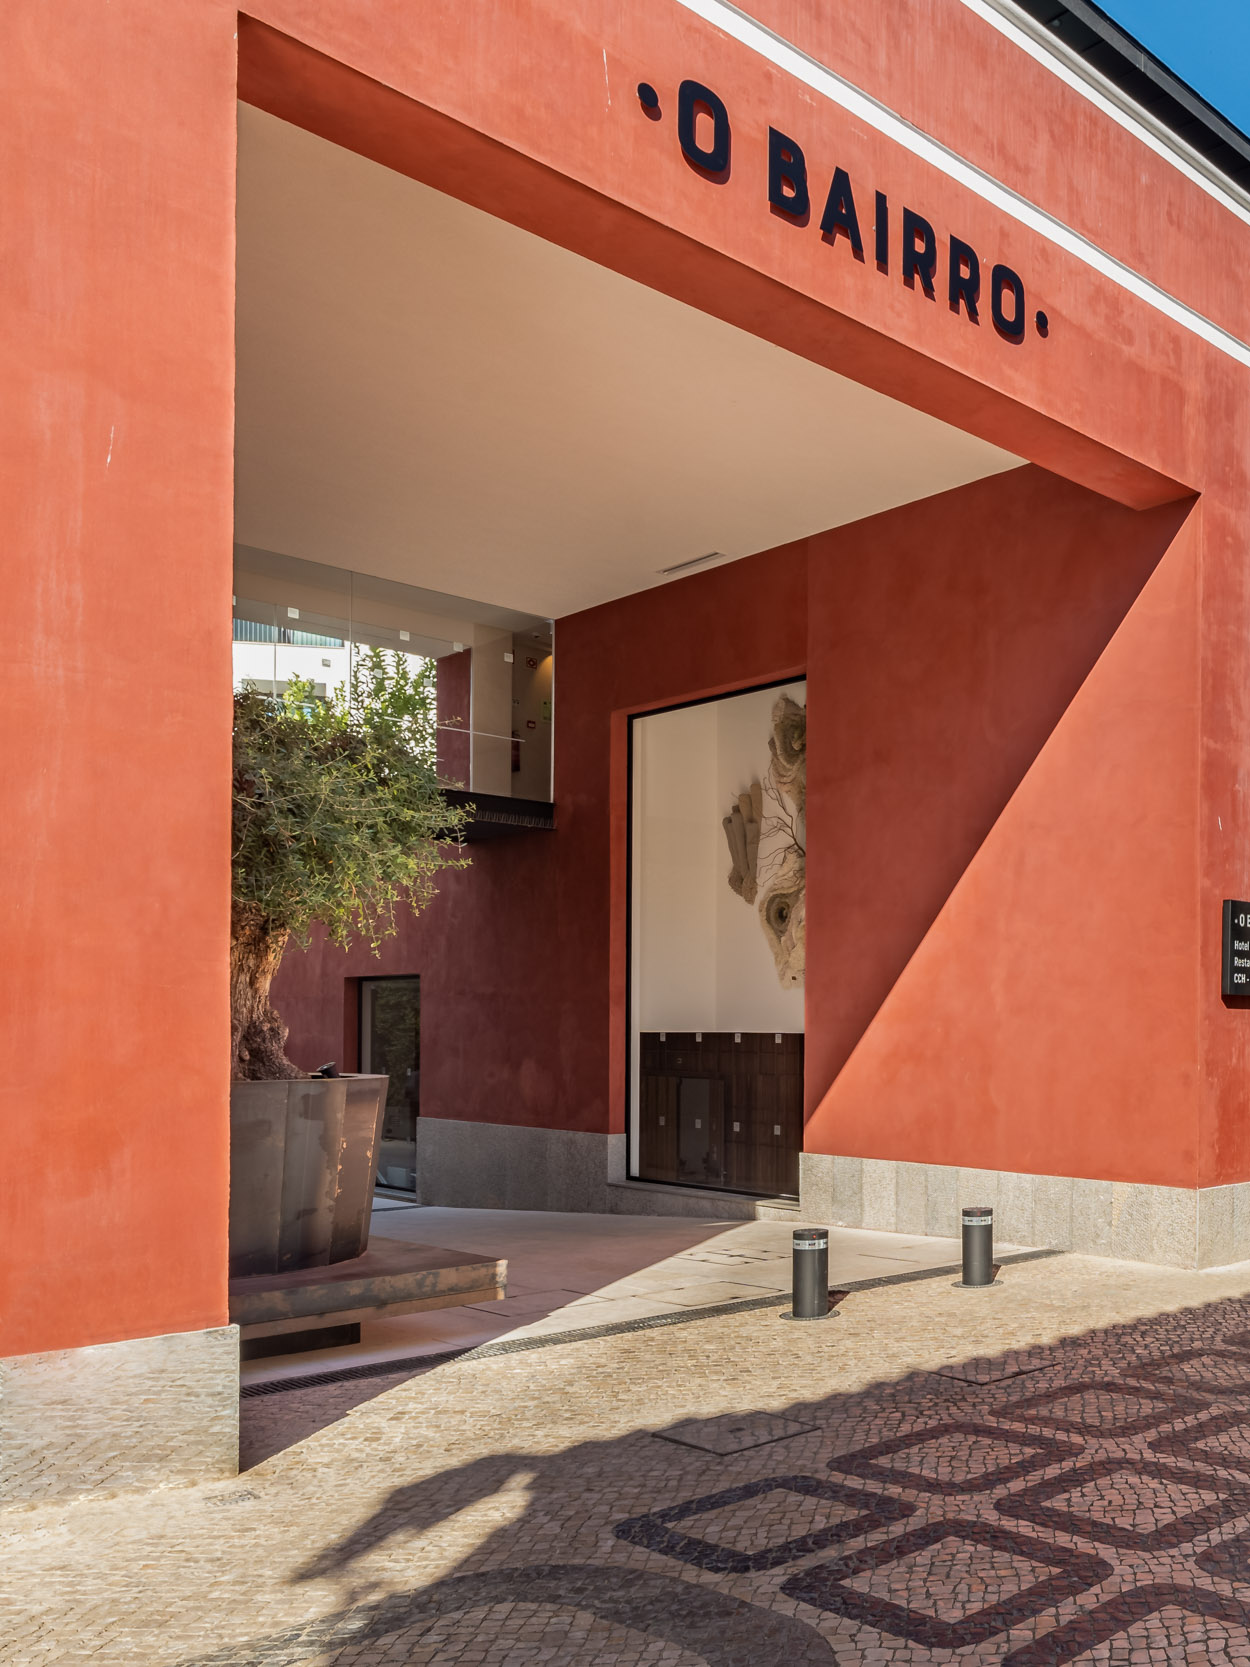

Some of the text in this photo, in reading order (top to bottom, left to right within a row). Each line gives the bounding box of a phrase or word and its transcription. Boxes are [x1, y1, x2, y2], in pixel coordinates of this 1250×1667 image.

[677, 79, 1026, 337] O BAIRRO
[1240, 914, 1245, 927] O
[1234, 940, 1250, 951] Hotel
[1233, 973, 1246, 984] CCH
